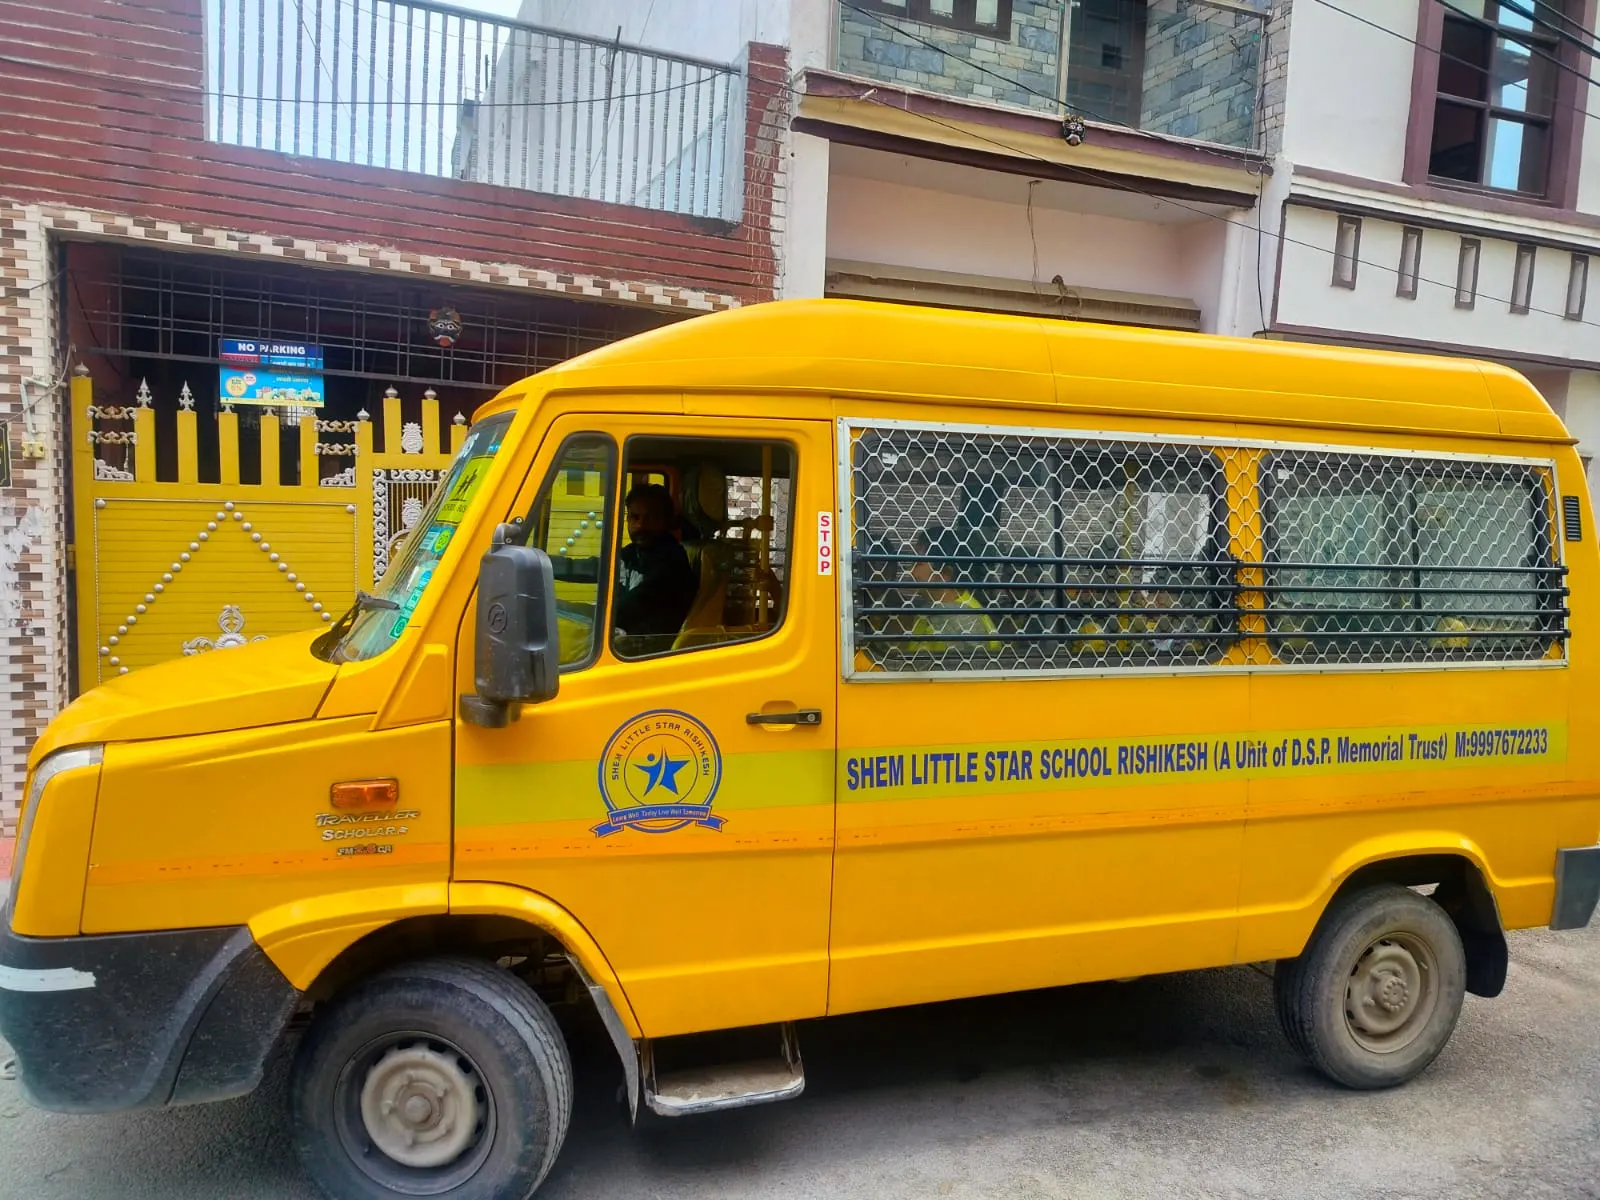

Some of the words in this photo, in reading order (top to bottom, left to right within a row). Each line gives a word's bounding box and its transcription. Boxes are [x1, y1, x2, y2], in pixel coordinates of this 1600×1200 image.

[238, 342, 255, 351] NO
[259, 344, 306, 355] PARKING
[820, 515, 831, 573] STOP
[612, 753, 624, 780] SHEM
[620, 725, 650, 750] LITTLE
[655, 722, 681, 731] STAR
[683, 728, 710, 776] RISHIKESH
[846, 754, 905, 791] SHEM
[910, 751, 979, 785] LITTLE
[983, 749, 1033, 781] STAR
[1039, 746, 1113, 779] SCHOOL
[1117, 741, 1208, 775] RISHIKESH
[1213, 741, 1231, 772] (A
[1235, 737, 1268, 769] Unit
[1271, 738, 1288, 767] of
[1291, 736, 1332, 766] D.S.P.
[1336, 734, 1404, 764] Memorial
[1408, 732, 1449, 761] Trust)
[1454, 728, 1548, 758] M:9997672233
[315, 809, 420, 827] TRAVELLER
